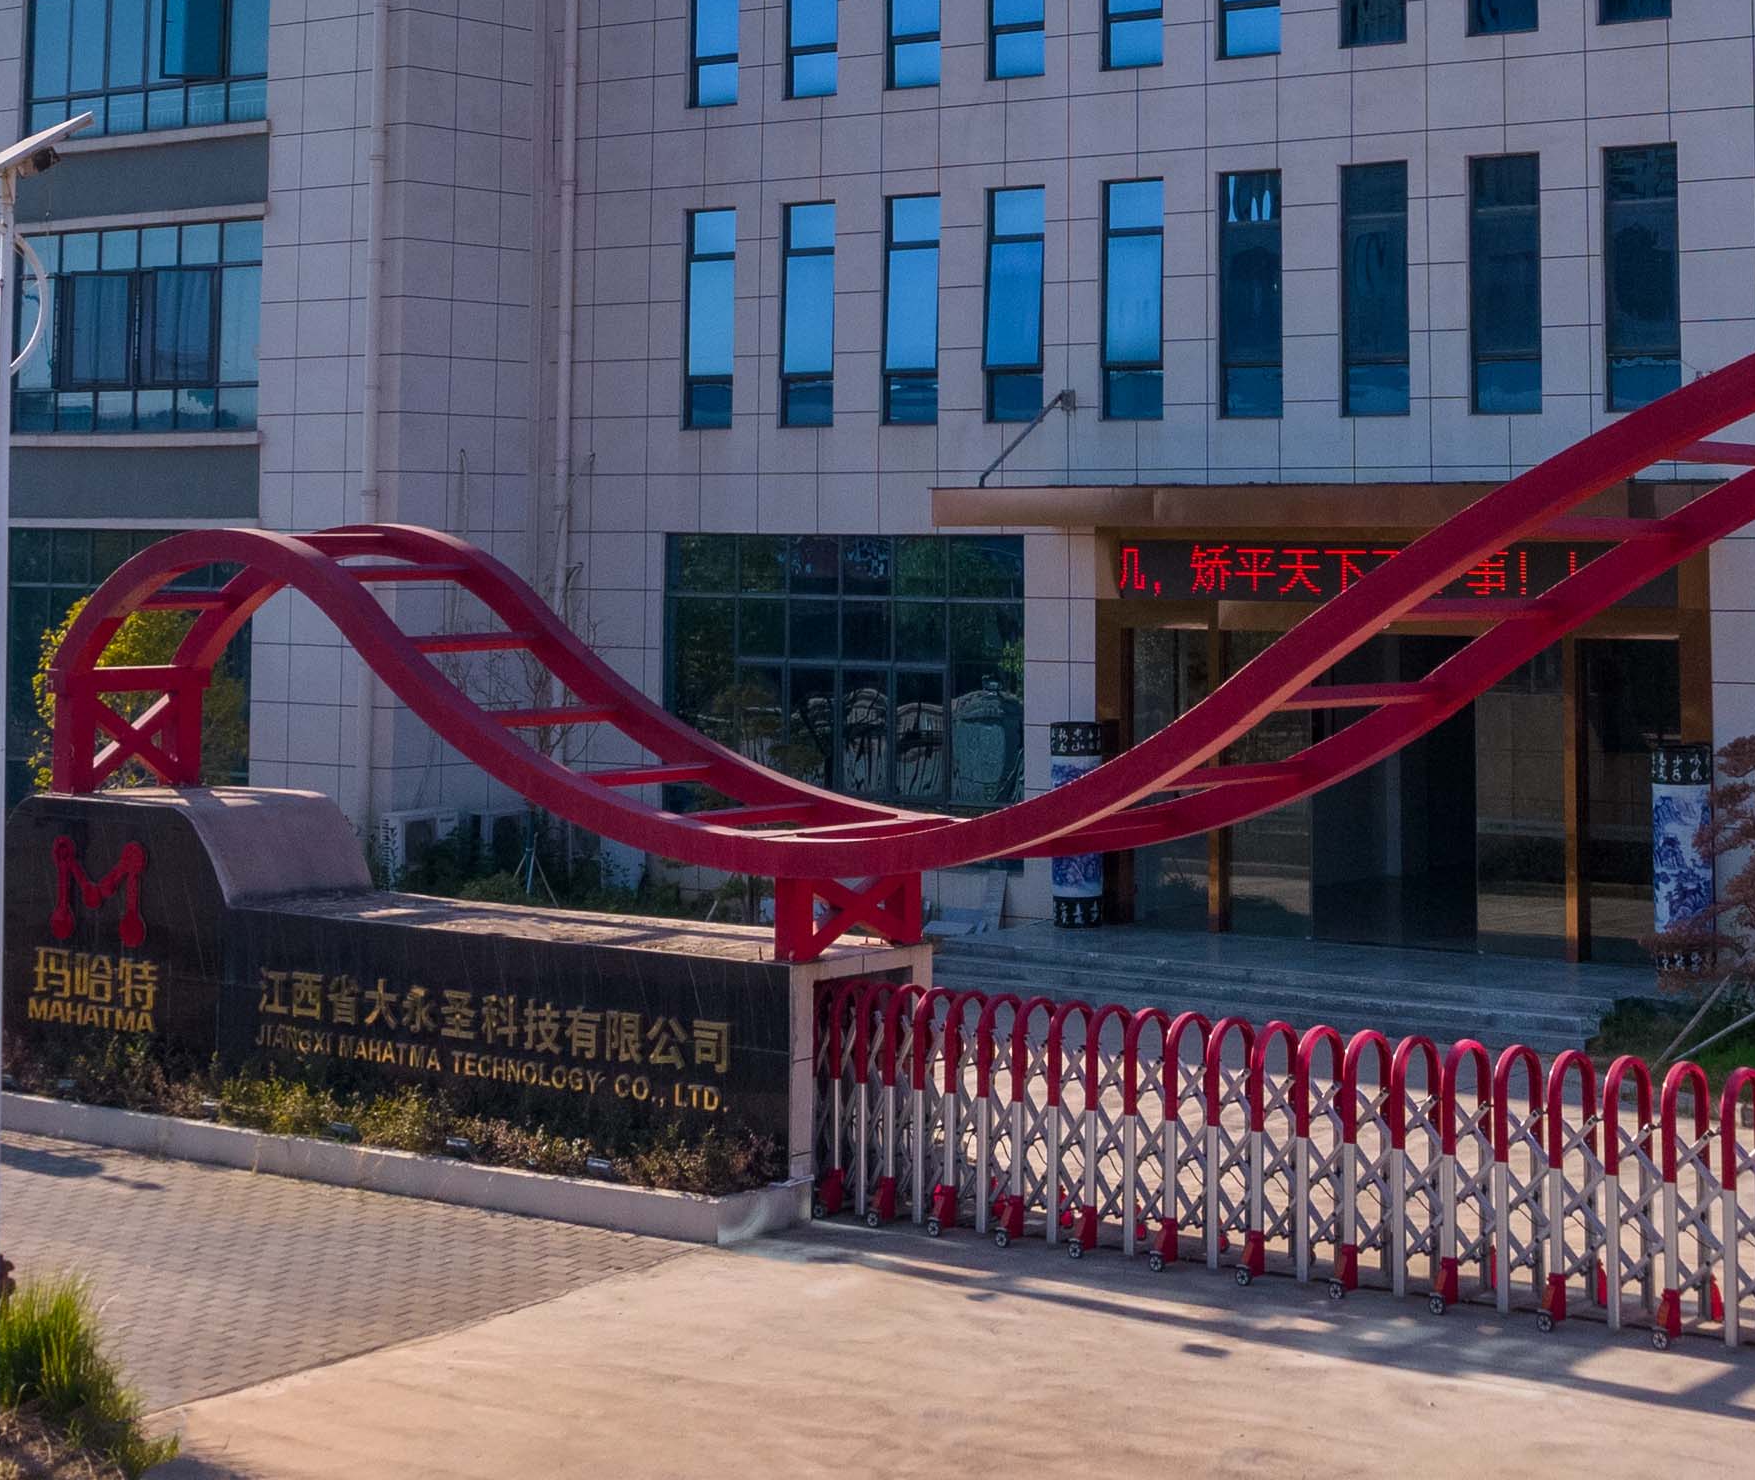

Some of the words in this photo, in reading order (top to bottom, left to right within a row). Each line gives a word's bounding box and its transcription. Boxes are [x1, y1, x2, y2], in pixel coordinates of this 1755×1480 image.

[28, 997, 155, 1032] MAHATMA
[34, 946, 160, 1010] 玛哈特
[258, 967, 731, 1073] 江西省大永圣科技有限公司
[255, 1023, 333, 1056] JIANGXI
[338, 1035, 441, 1072] MAHATMA
[451, 1049, 606, 1096] TECHNOLOGY
[673, 1082, 730, 1113] LTD.
